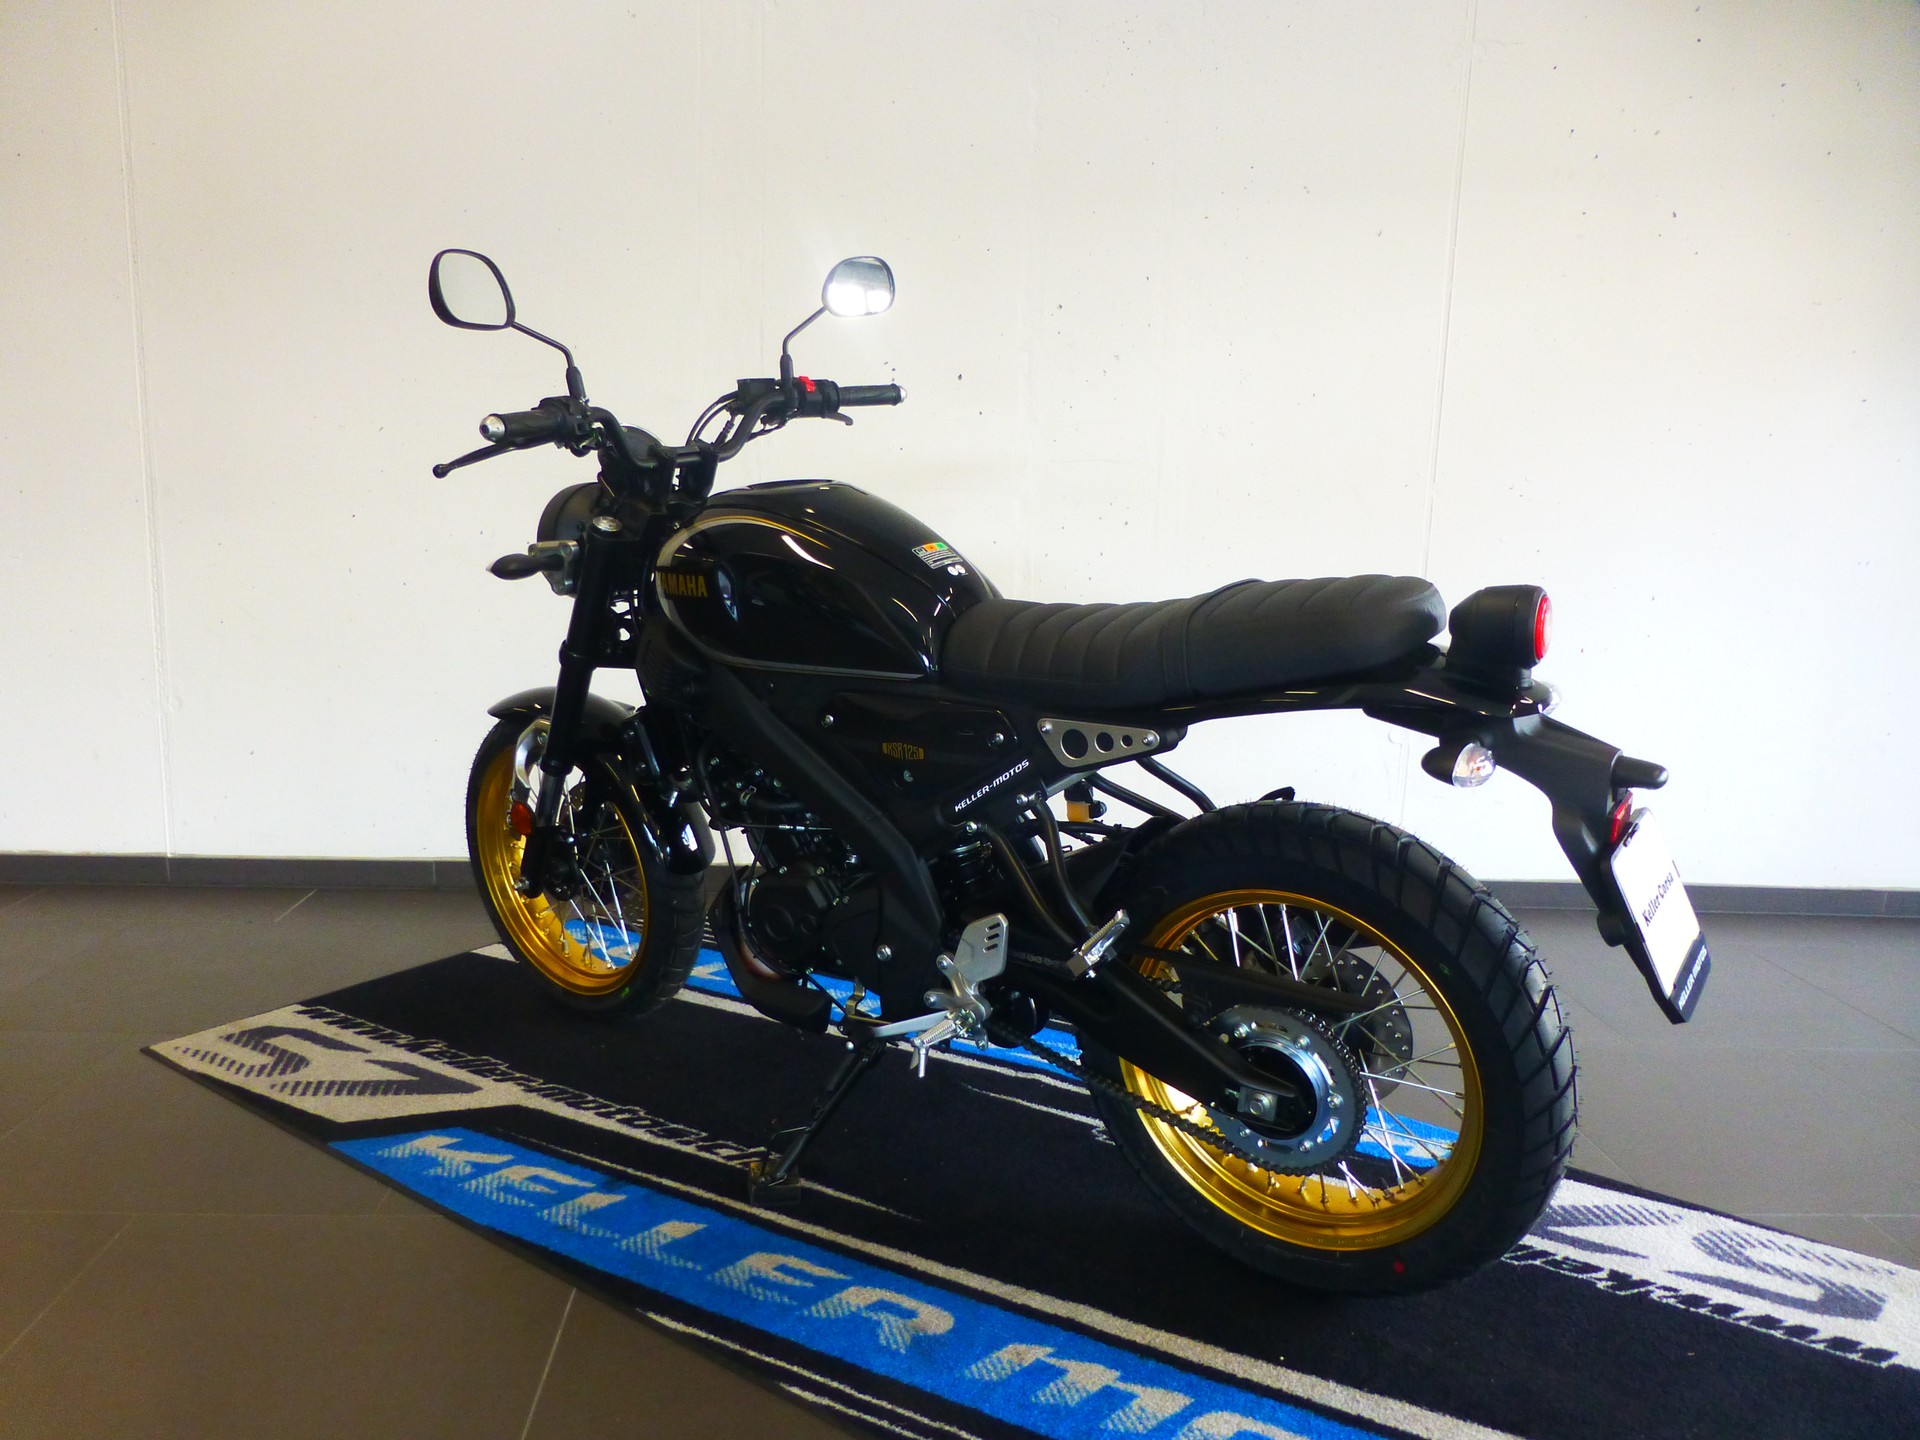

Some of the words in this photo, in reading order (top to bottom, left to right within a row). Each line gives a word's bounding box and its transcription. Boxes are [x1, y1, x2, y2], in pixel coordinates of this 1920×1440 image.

[886, 741, 920, 761] XSR125
[953, 758, 1031, 813] KELLER-MOTOS
[1641, 894, 1662, 927] Keller
[1656, 871, 1675, 899] Corsa
[369, 1133, 956, 1354] KELLER
